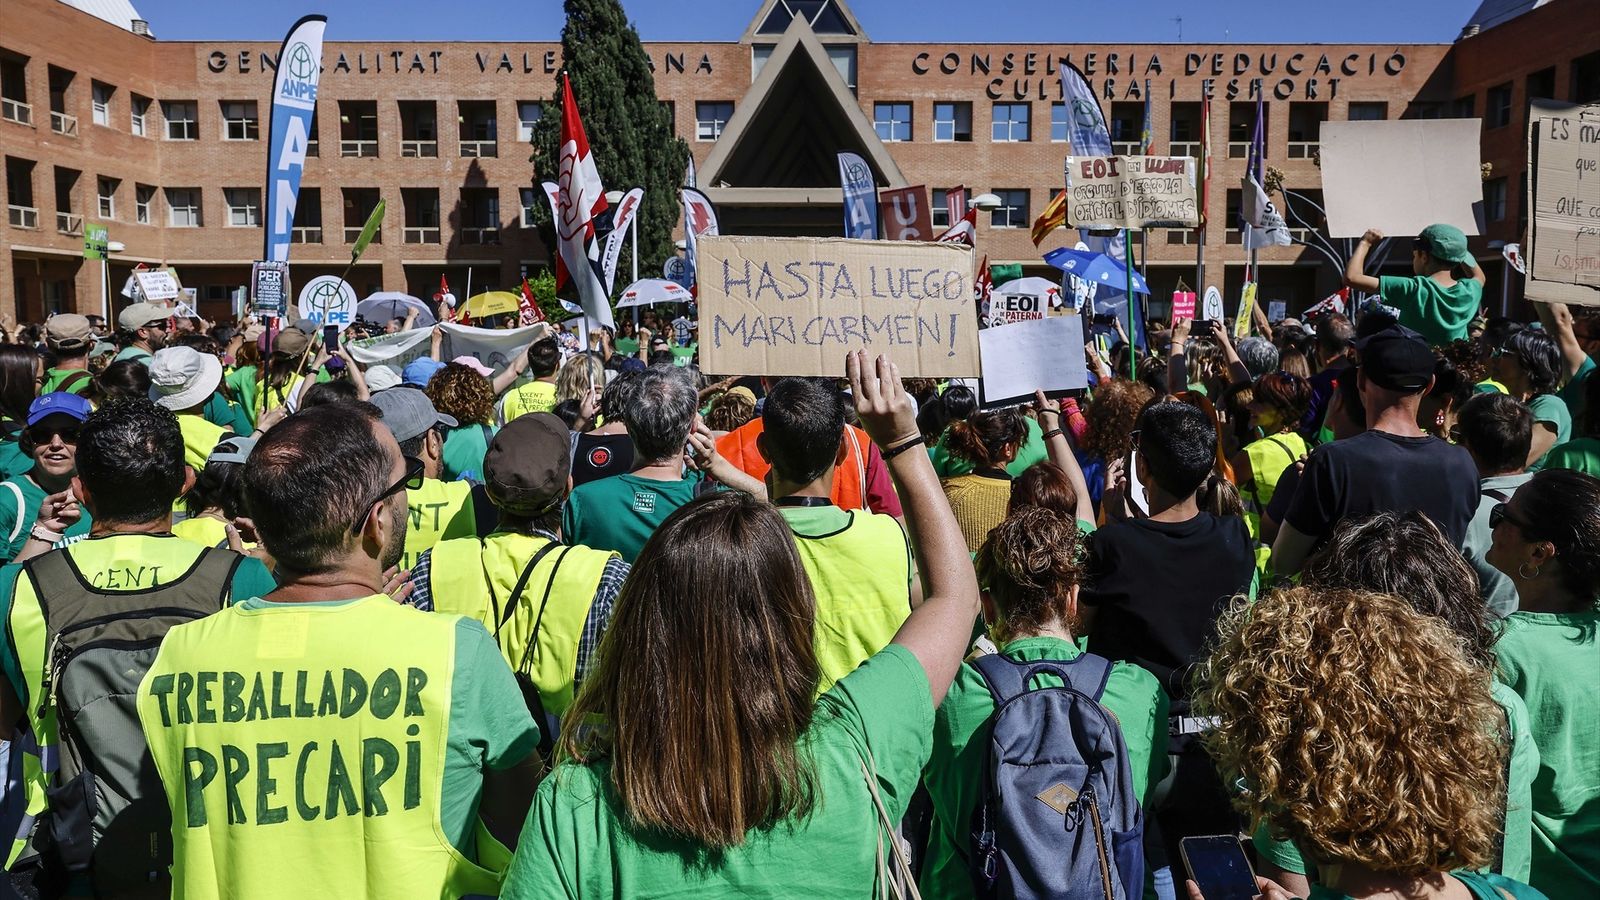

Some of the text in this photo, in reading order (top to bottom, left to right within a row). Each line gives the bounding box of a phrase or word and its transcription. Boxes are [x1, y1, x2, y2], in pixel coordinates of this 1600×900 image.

[207, 51, 713, 74] GENALITAT VALEANA
[1185, 47, 1406, 76] D'EDUCACIÓ
[281, 79, 317, 101] ANPE
[986, 79, 1142, 100] CULRA
[1170, 79, 1176, 100] I
[1551, 117, 1569, 140] ES
[1081, 157, 1120, 179] EOI
[1576, 158, 1597, 180] que
[1074, 177, 1183, 201] ORGULL D'ESCOLA
[1556, 197, 1583, 217] QUE
[259, 271, 281, 281] PER
[723, 258, 858, 301] HASTA
[869, 265, 968, 305] LUEGO,
[1006, 312, 1043, 320] PATERNA
[150, 667, 428, 727] TREBALLADOR
